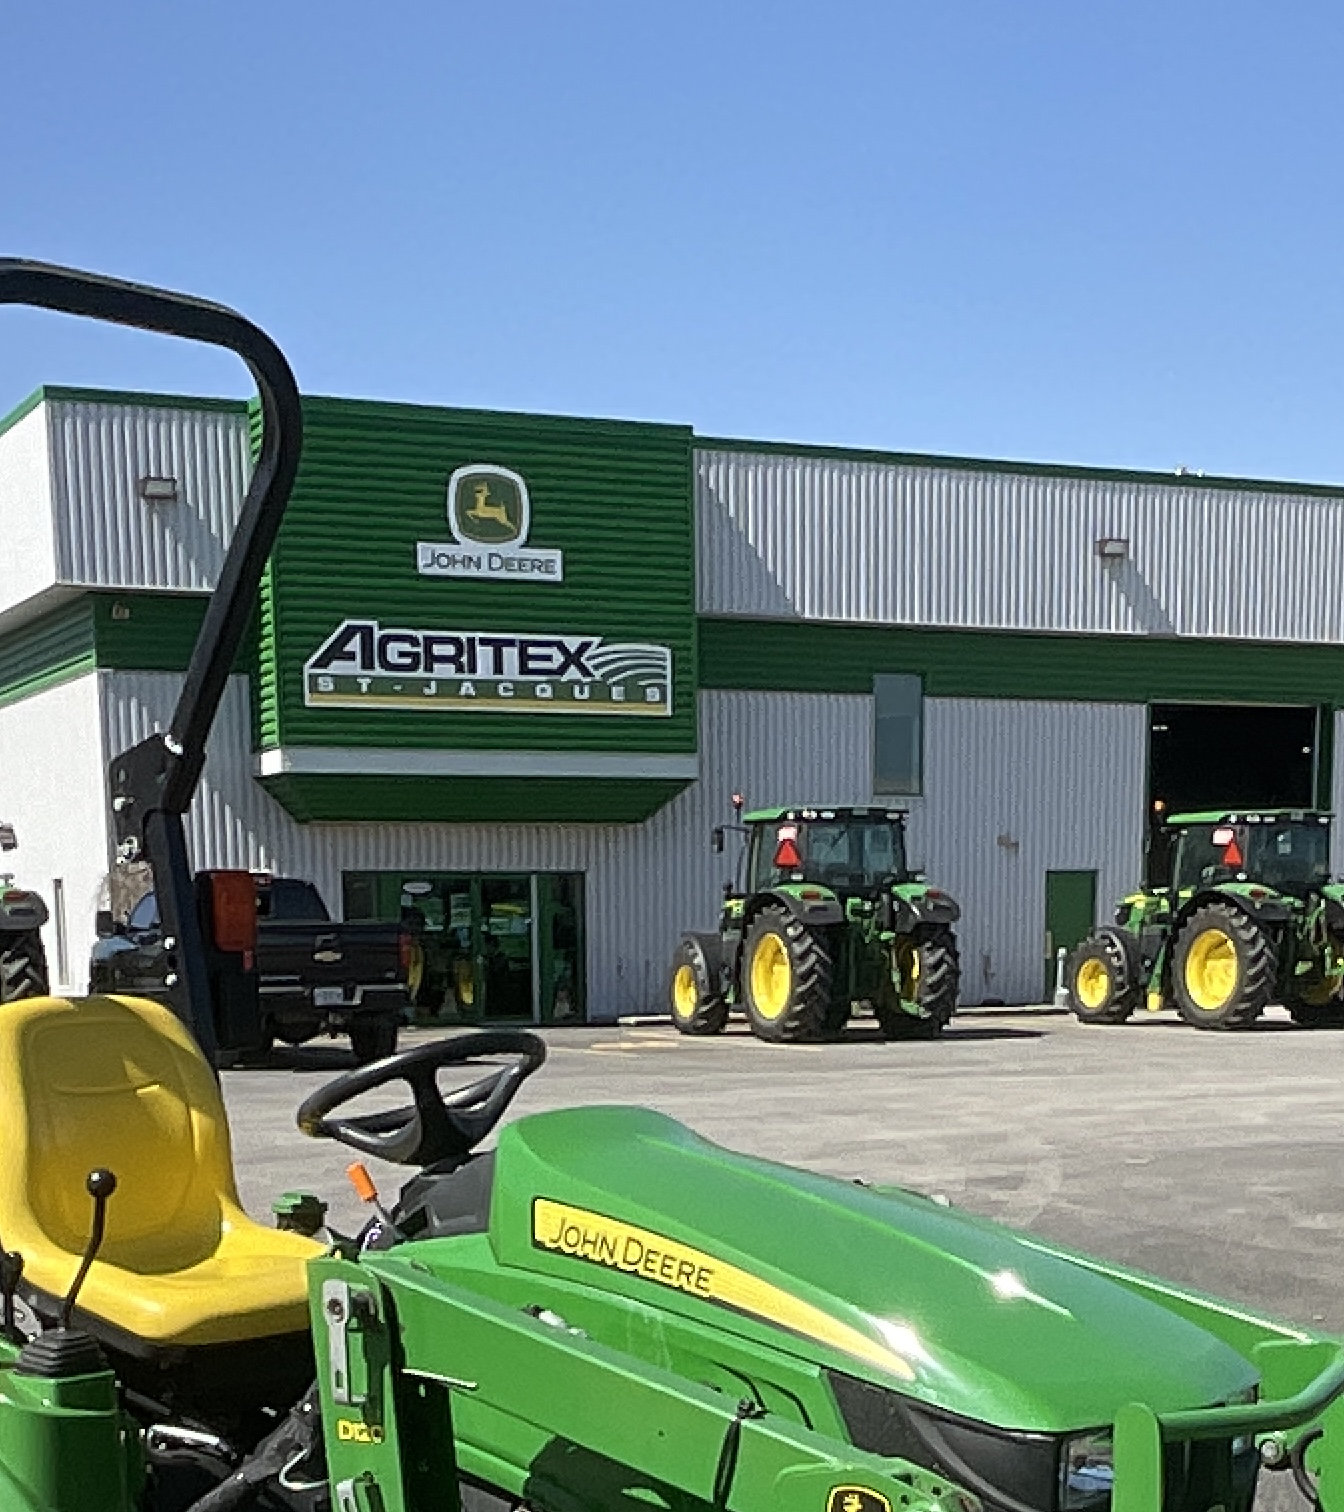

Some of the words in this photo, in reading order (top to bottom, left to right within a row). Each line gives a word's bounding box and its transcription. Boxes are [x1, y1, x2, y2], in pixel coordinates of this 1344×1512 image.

[422, 549, 482, 572] JOHN
[488, 552, 558, 576] DEERE
[309, 624, 597, 678] AGRITEX
[316, 675, 661, 702] ST-JACQUES
[548, 1217, 618, 1260] JOHN
[622, 1236, 716, 1292] DEERE
